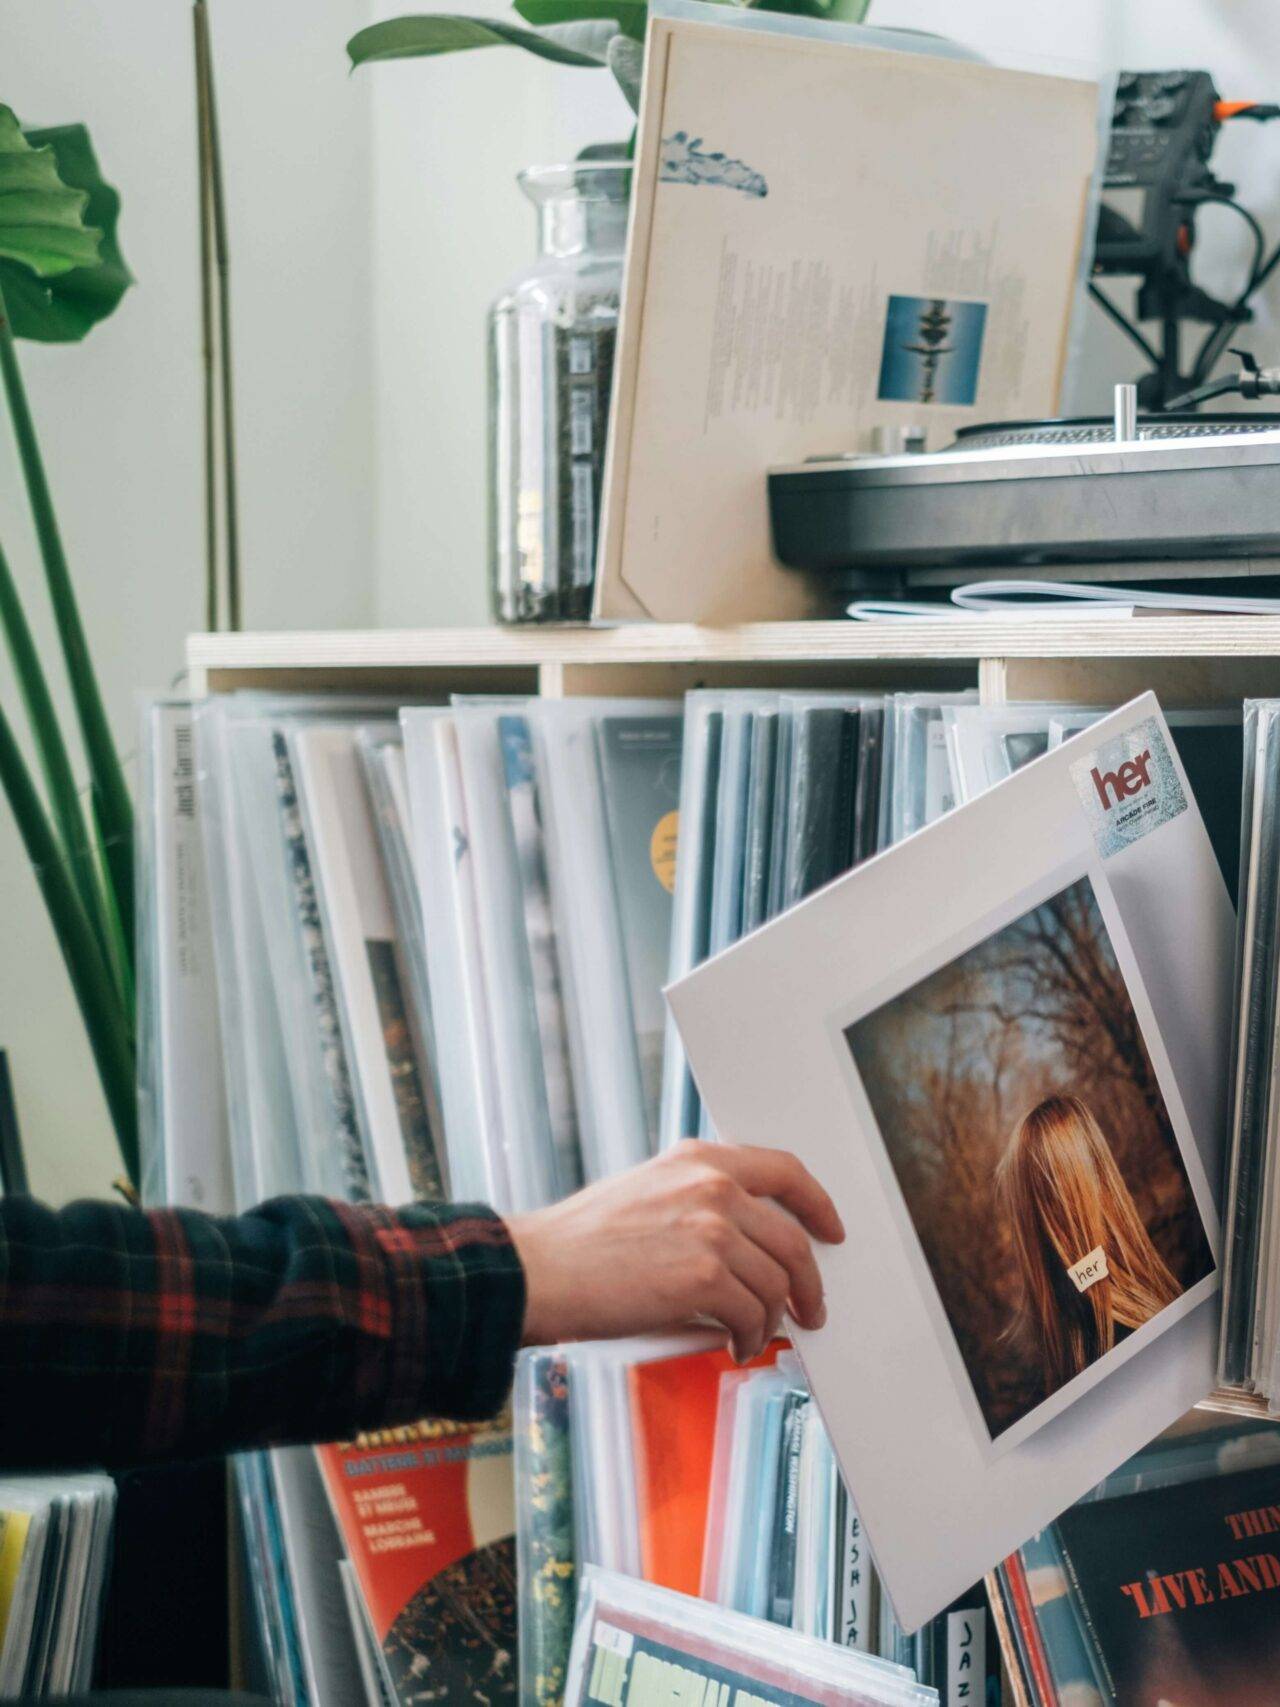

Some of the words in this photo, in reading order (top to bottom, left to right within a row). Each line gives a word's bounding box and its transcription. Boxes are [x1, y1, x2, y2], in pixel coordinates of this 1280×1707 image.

[1090, 749, 1151, 811] her
[1115, 806, 1142, 827] ARCADE
[1075, 1260, 1099, 1285] her
[957, 1621, 973, 1707] JAZ
